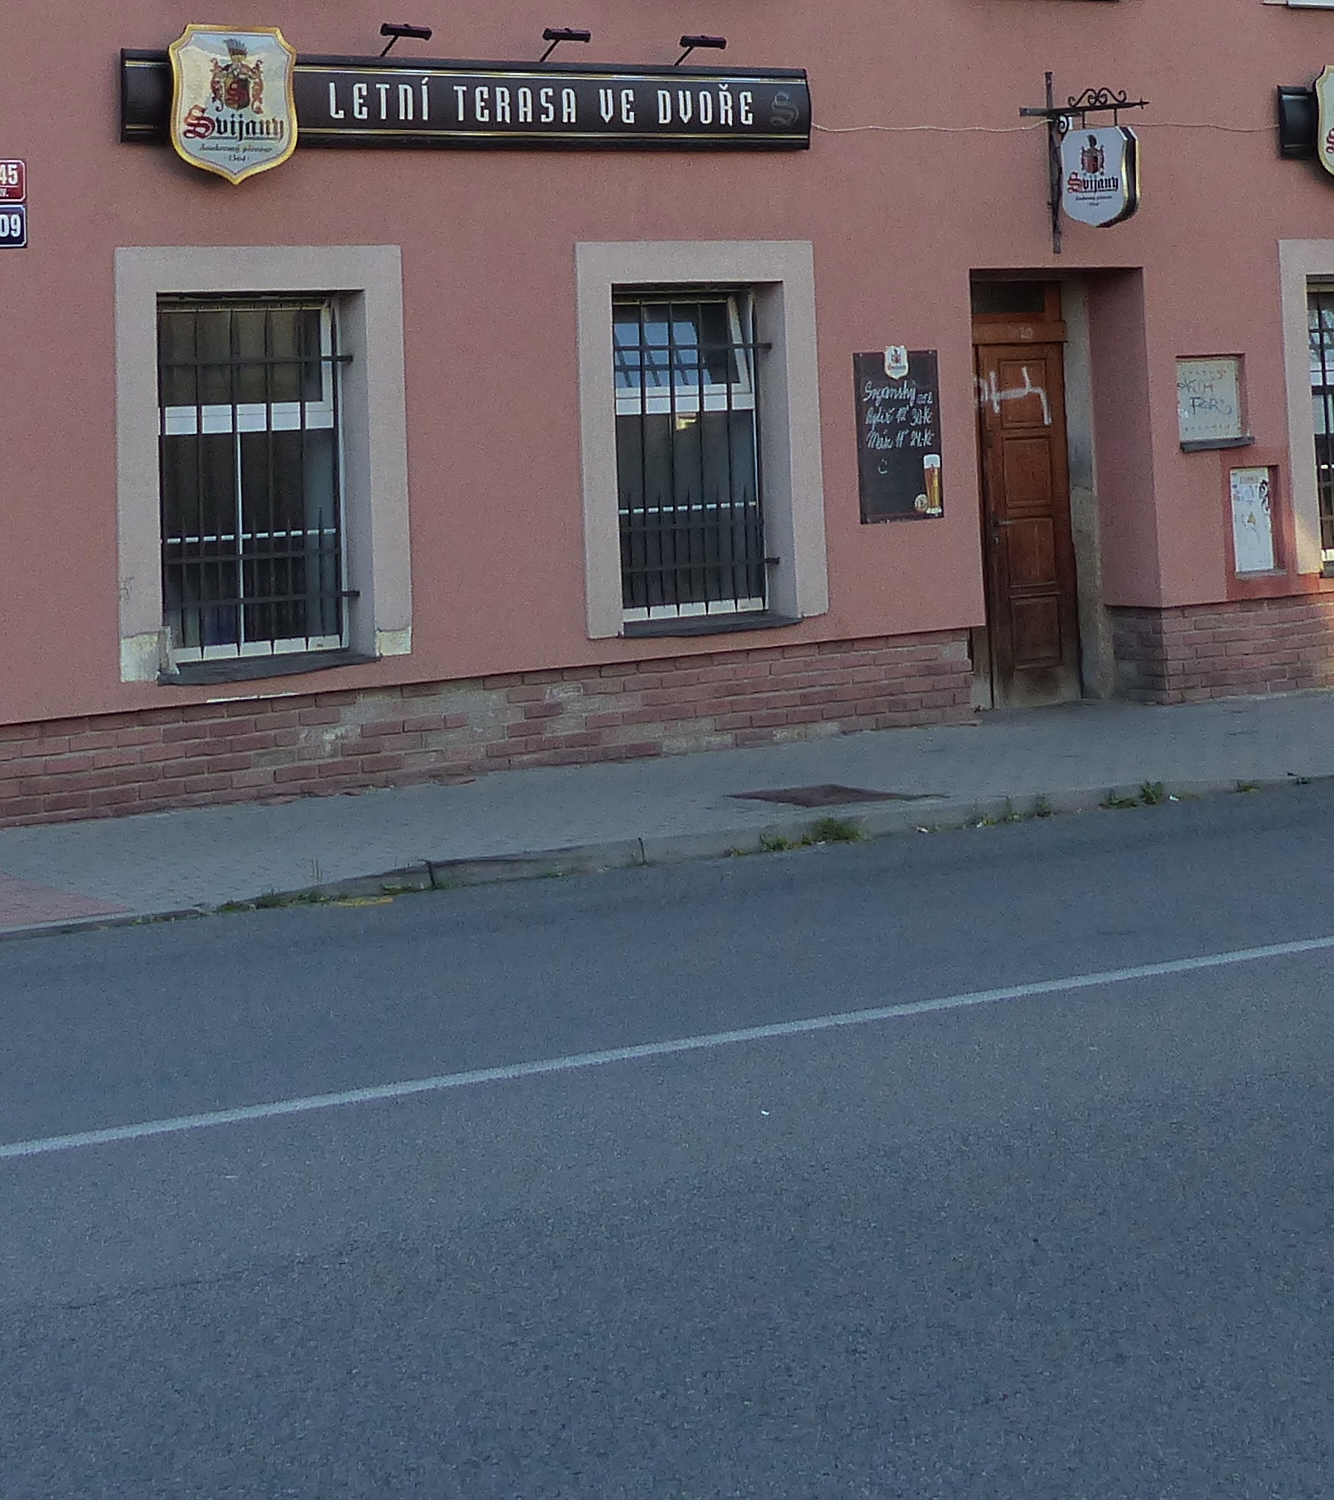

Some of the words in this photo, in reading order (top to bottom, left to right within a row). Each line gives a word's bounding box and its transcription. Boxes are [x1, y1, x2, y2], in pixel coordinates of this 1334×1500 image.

[328, 77, 430, 121] LETNÍ
[453, 85, 577, 124] TERASA
[599, 88, 635, 123] VE
[657, 83, 754, 126] DVOŘE
[183, 104, 285, 142] Svijany
[1067, 171, 1119, 194] Svijany
